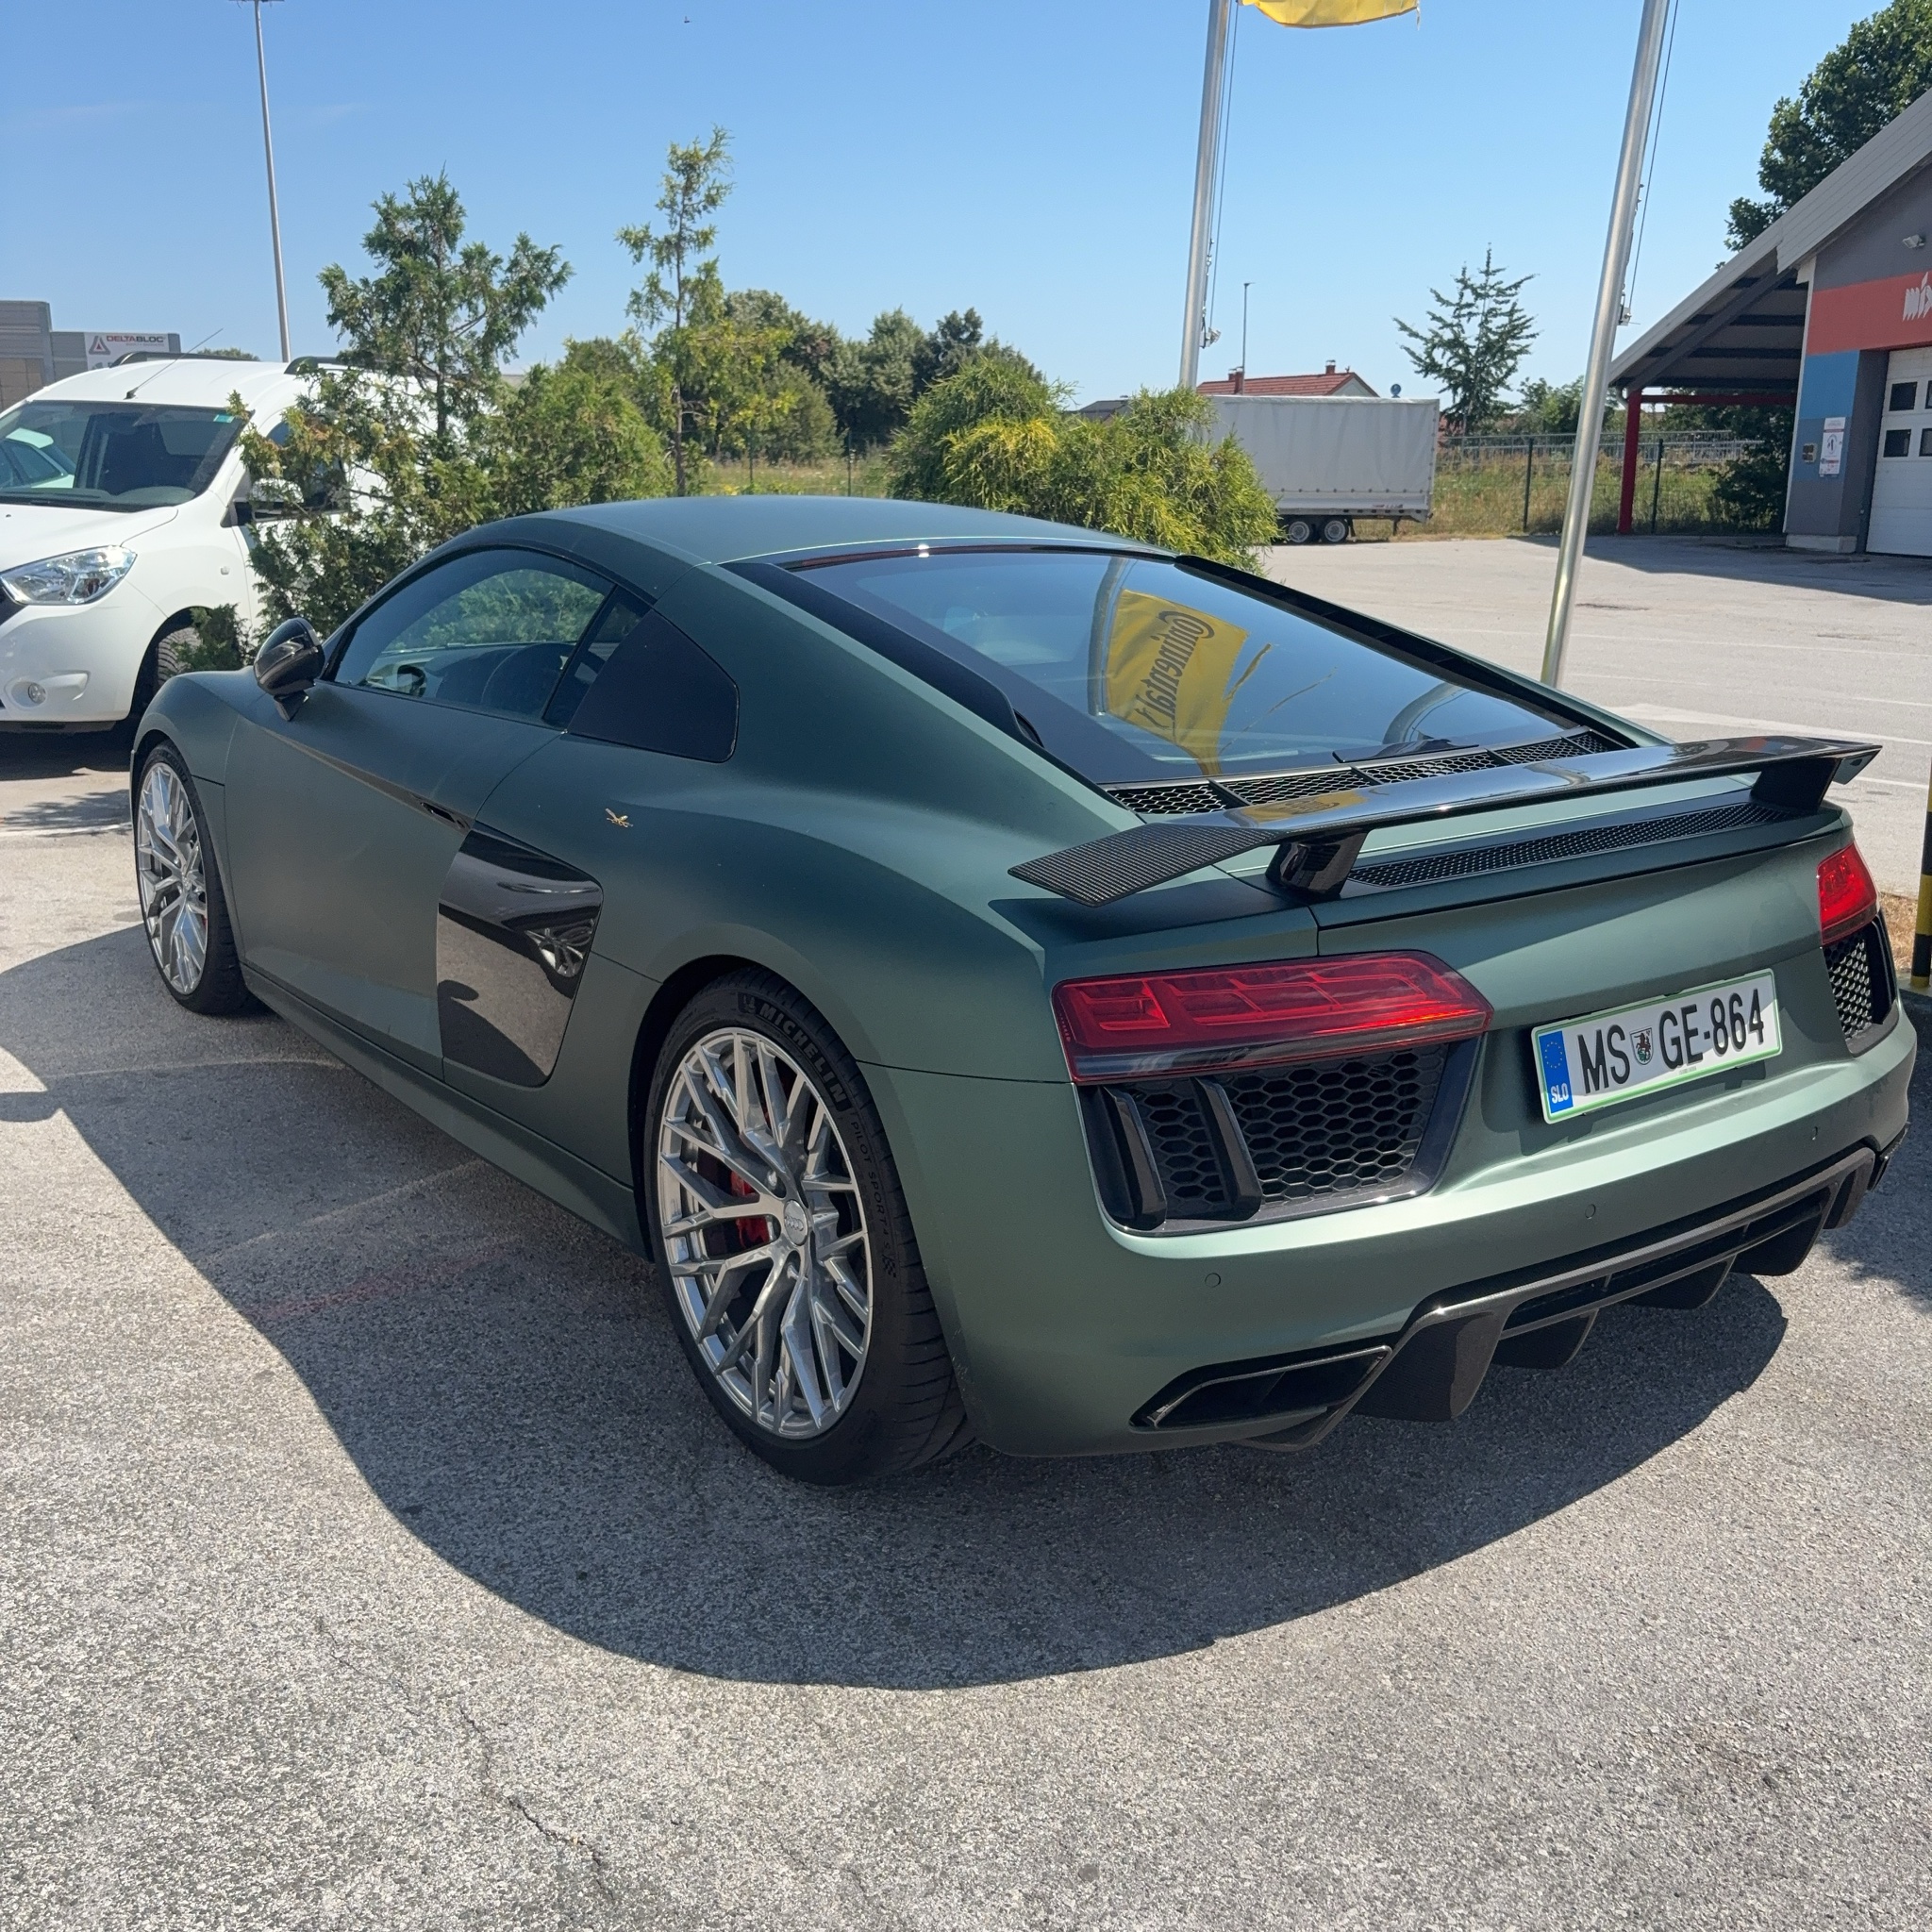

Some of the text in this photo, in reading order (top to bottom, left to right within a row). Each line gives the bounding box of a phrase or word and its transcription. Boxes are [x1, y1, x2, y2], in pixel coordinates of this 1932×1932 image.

[759, 1003, 847, 1103] MICHELIN
[1577, 988, 1765, 1094] MS GE-864
[1551, 1082, 1570, 1105] SLO
[851, 1122, 873, 1164] PILOT
[868, 1172, 888, 1226] SPORT
